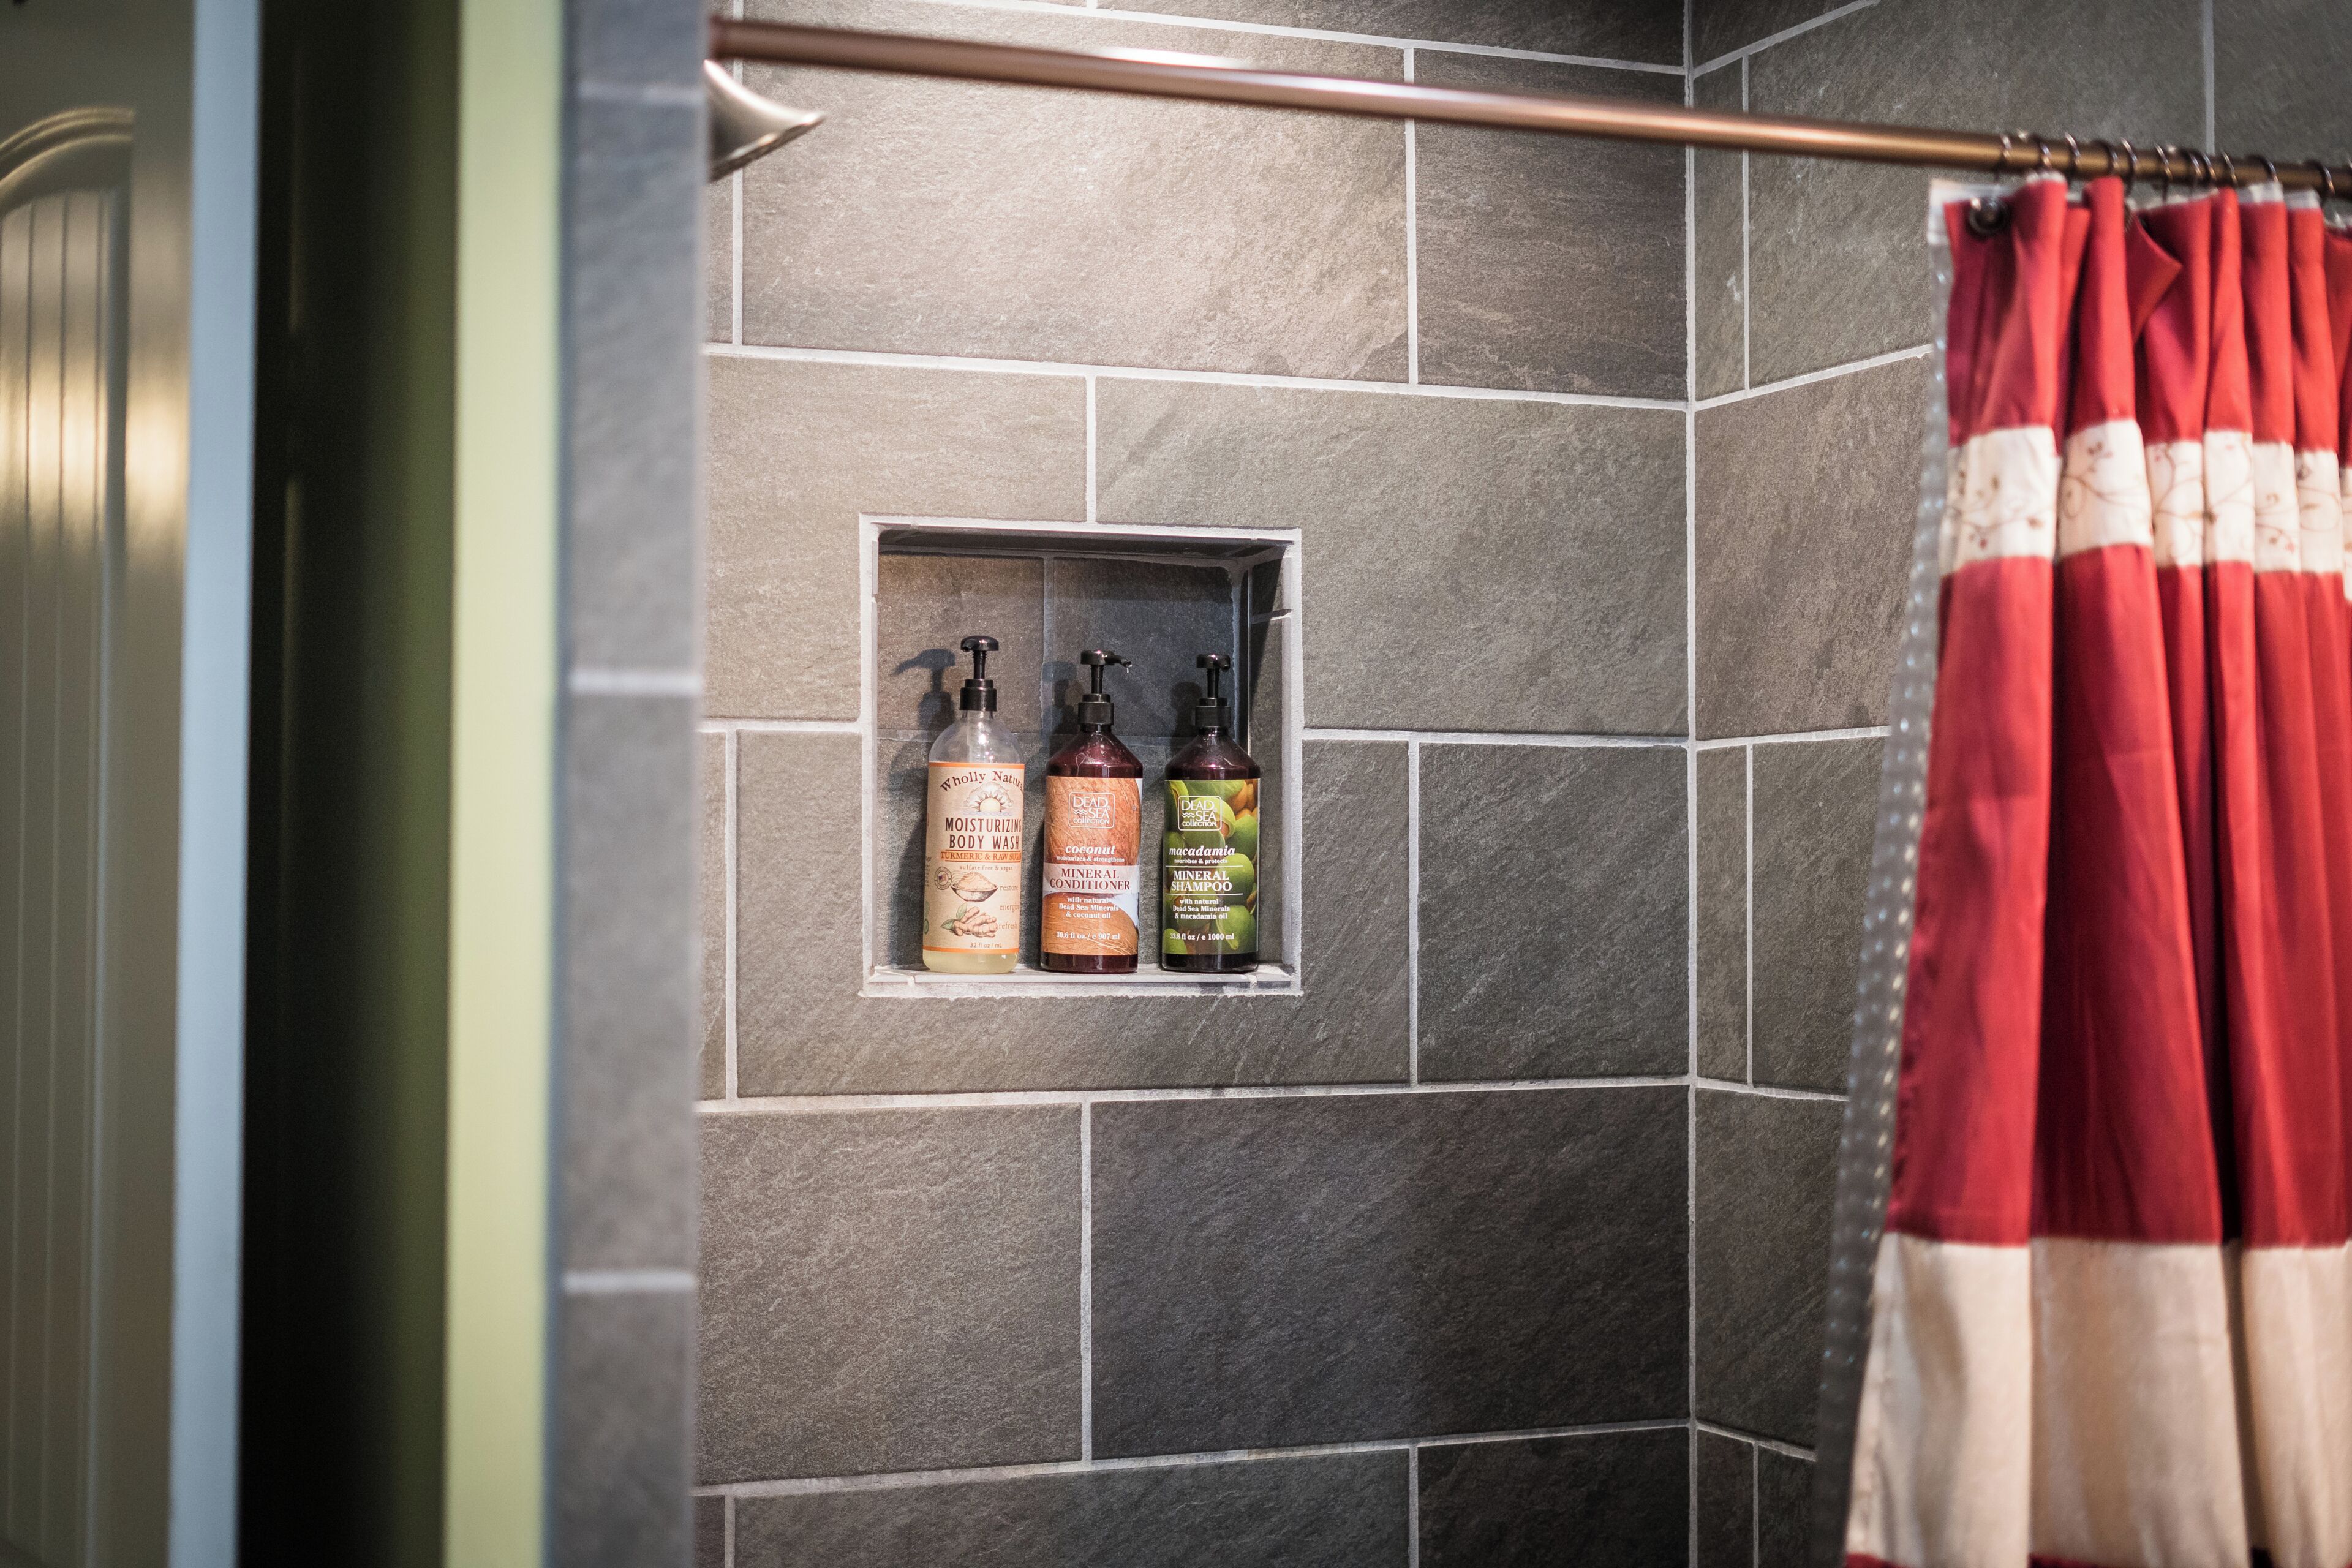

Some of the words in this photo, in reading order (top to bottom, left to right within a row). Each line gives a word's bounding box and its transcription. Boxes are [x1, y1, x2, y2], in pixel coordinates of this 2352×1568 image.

[940, 772, 986, 792] Wholly
[1073, 796, 1109, 808] DEAD
[1182, 800, 1215, 811] DEAD
[1088, 808, 1110, 819] SEA
[1196, 810, 1217, 821] SEA
[945, 818, 1022, 832] MOISTURIZING
[949, 835, 984, 849] BODY
[992, 835, 1019, 850] WASH
[1065, 845, 1116, 854] coconut
[1169, 845, 1235, 856] macadamia
[940, 851, 982, 860] TURMERIC
[1061, 868, 1119, 879] MINERAL
[1174, 870, 1229, 880] MINERAL
[1050, 878, 1130, 890] CONDITIONER
[1171, 881, 1232, 891] SHAMPOO
